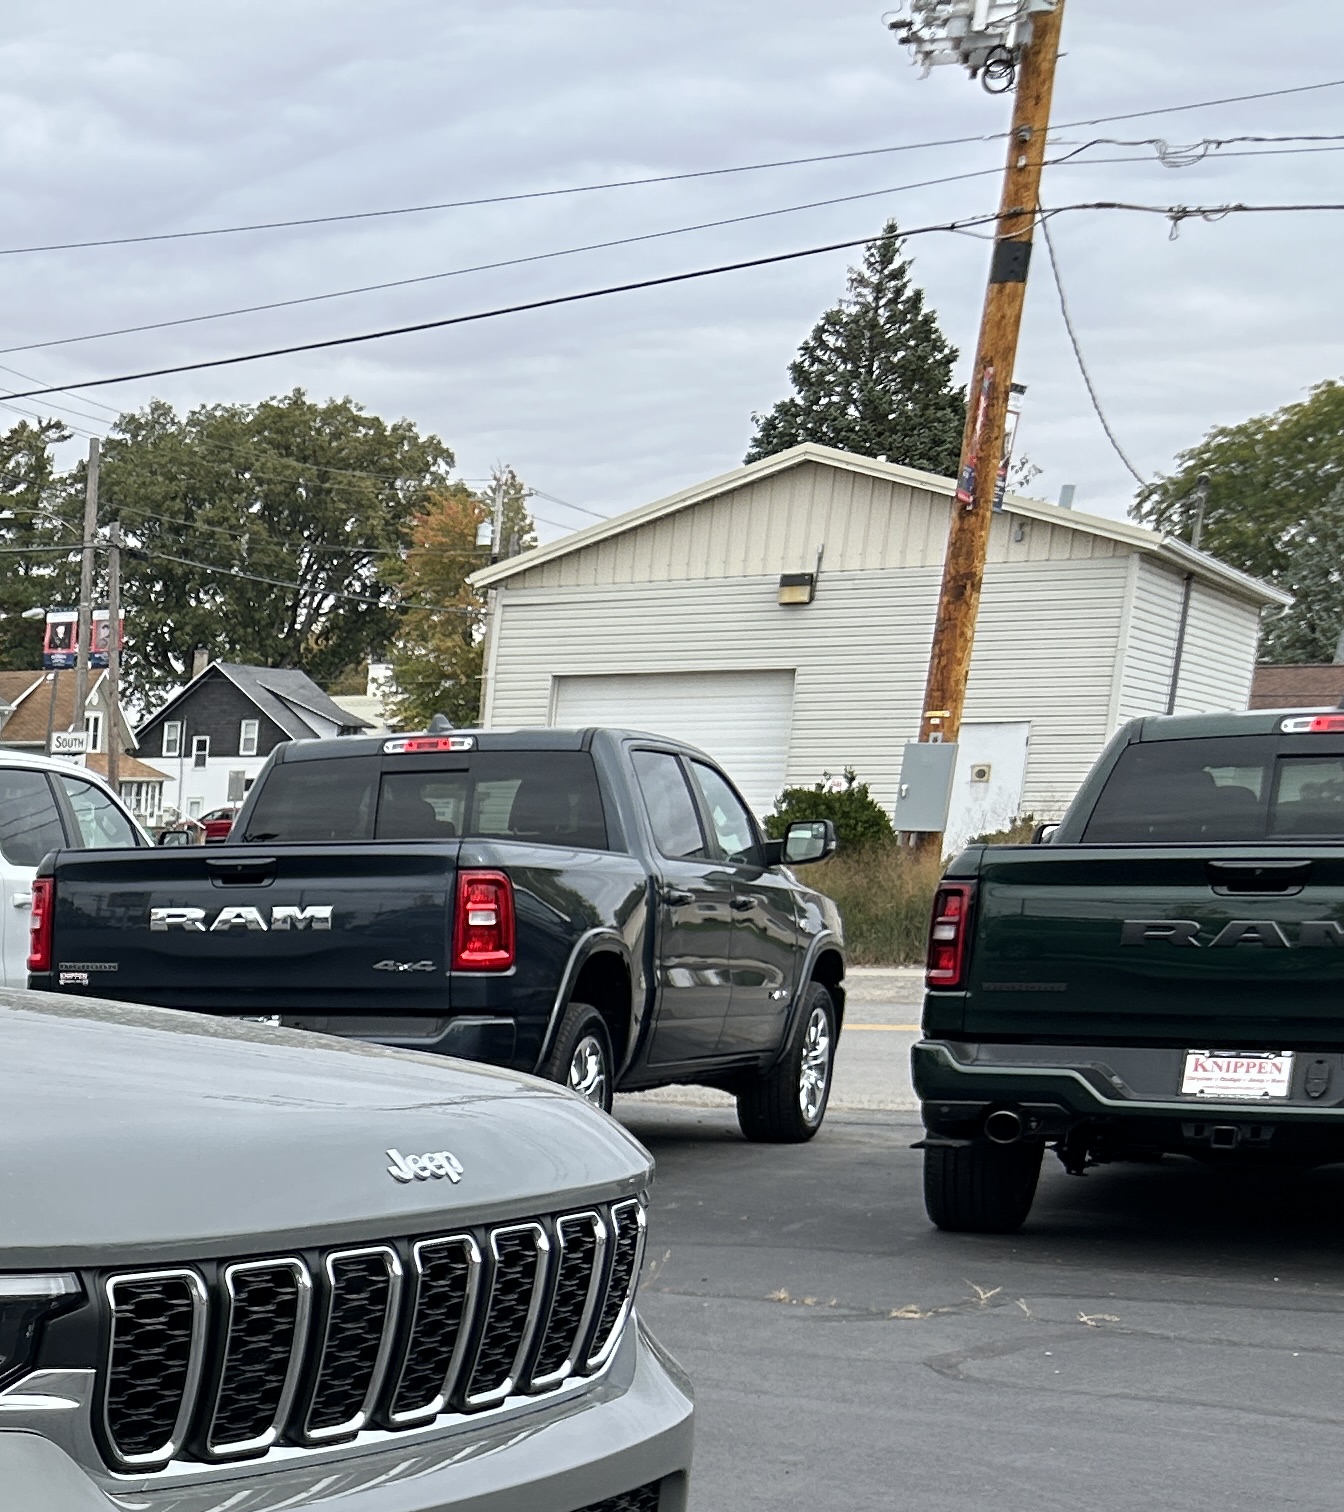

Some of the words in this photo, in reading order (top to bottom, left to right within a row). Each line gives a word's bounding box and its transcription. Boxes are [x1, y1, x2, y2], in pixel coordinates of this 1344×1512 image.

[150, 905, 334, 931] RAM
[1192, 1057, 1285, 1075] KNIPPEN
[385, 1147, 464, 1184] Jeep
